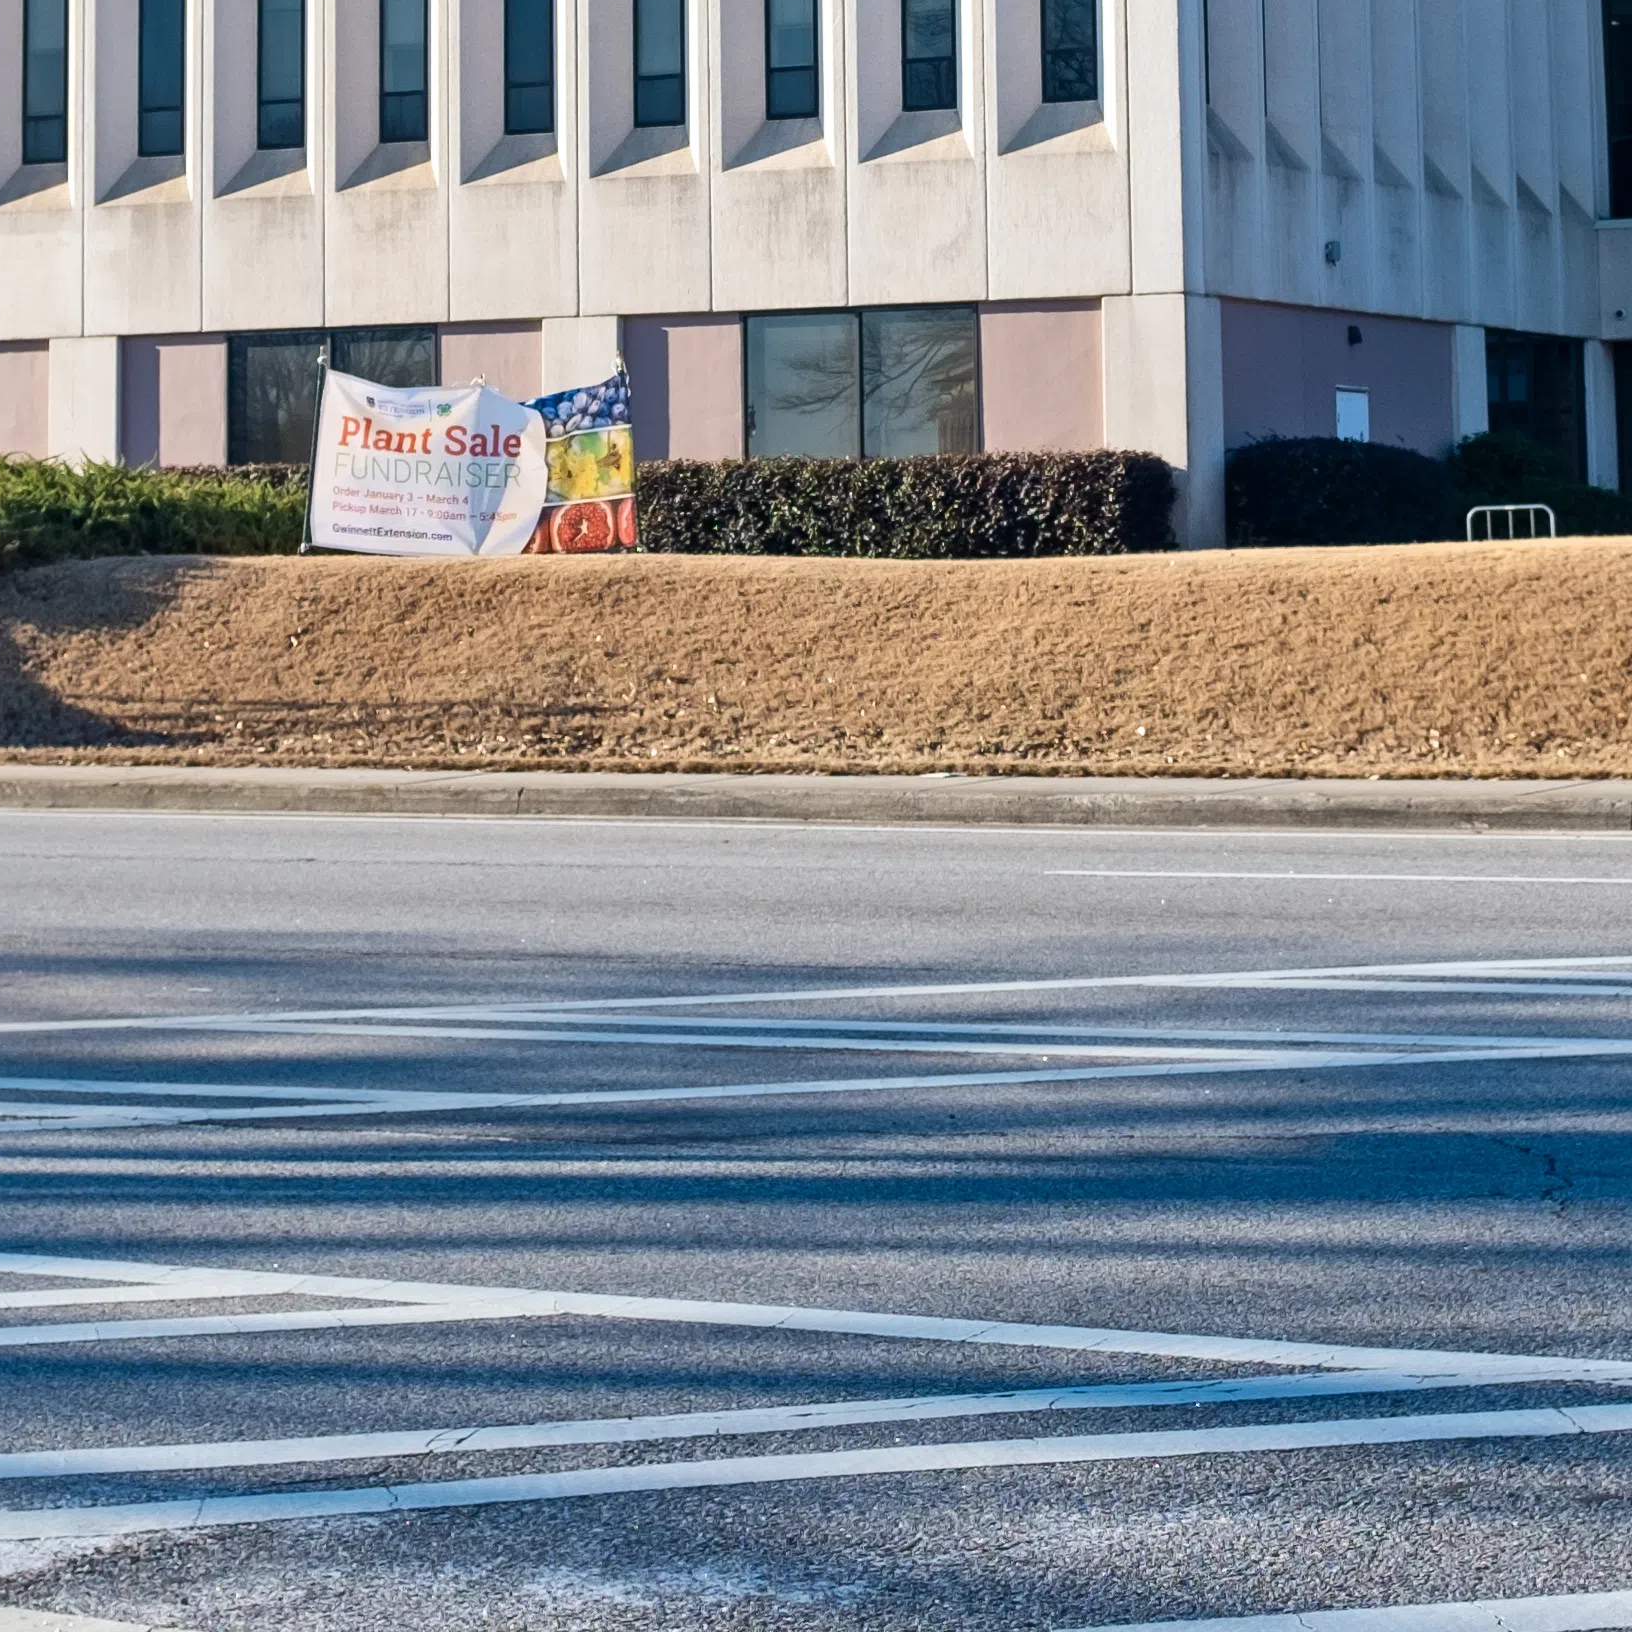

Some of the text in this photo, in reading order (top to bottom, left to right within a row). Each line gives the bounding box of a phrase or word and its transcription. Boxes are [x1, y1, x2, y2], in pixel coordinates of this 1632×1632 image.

[337, 415, 522, 458] Plant Sale
[334, 451, 521, 489] FUNDRAISER
[332, 485, 360, 497] Order
[364, 488, 405, 503] January
[407, 492, 414, 502] 3
[426, 494, 459, 505] March
[332, 500, 367, 514] Pickup
[369, 504, 402, 516] March
[406, 507, 418, 517] 17
